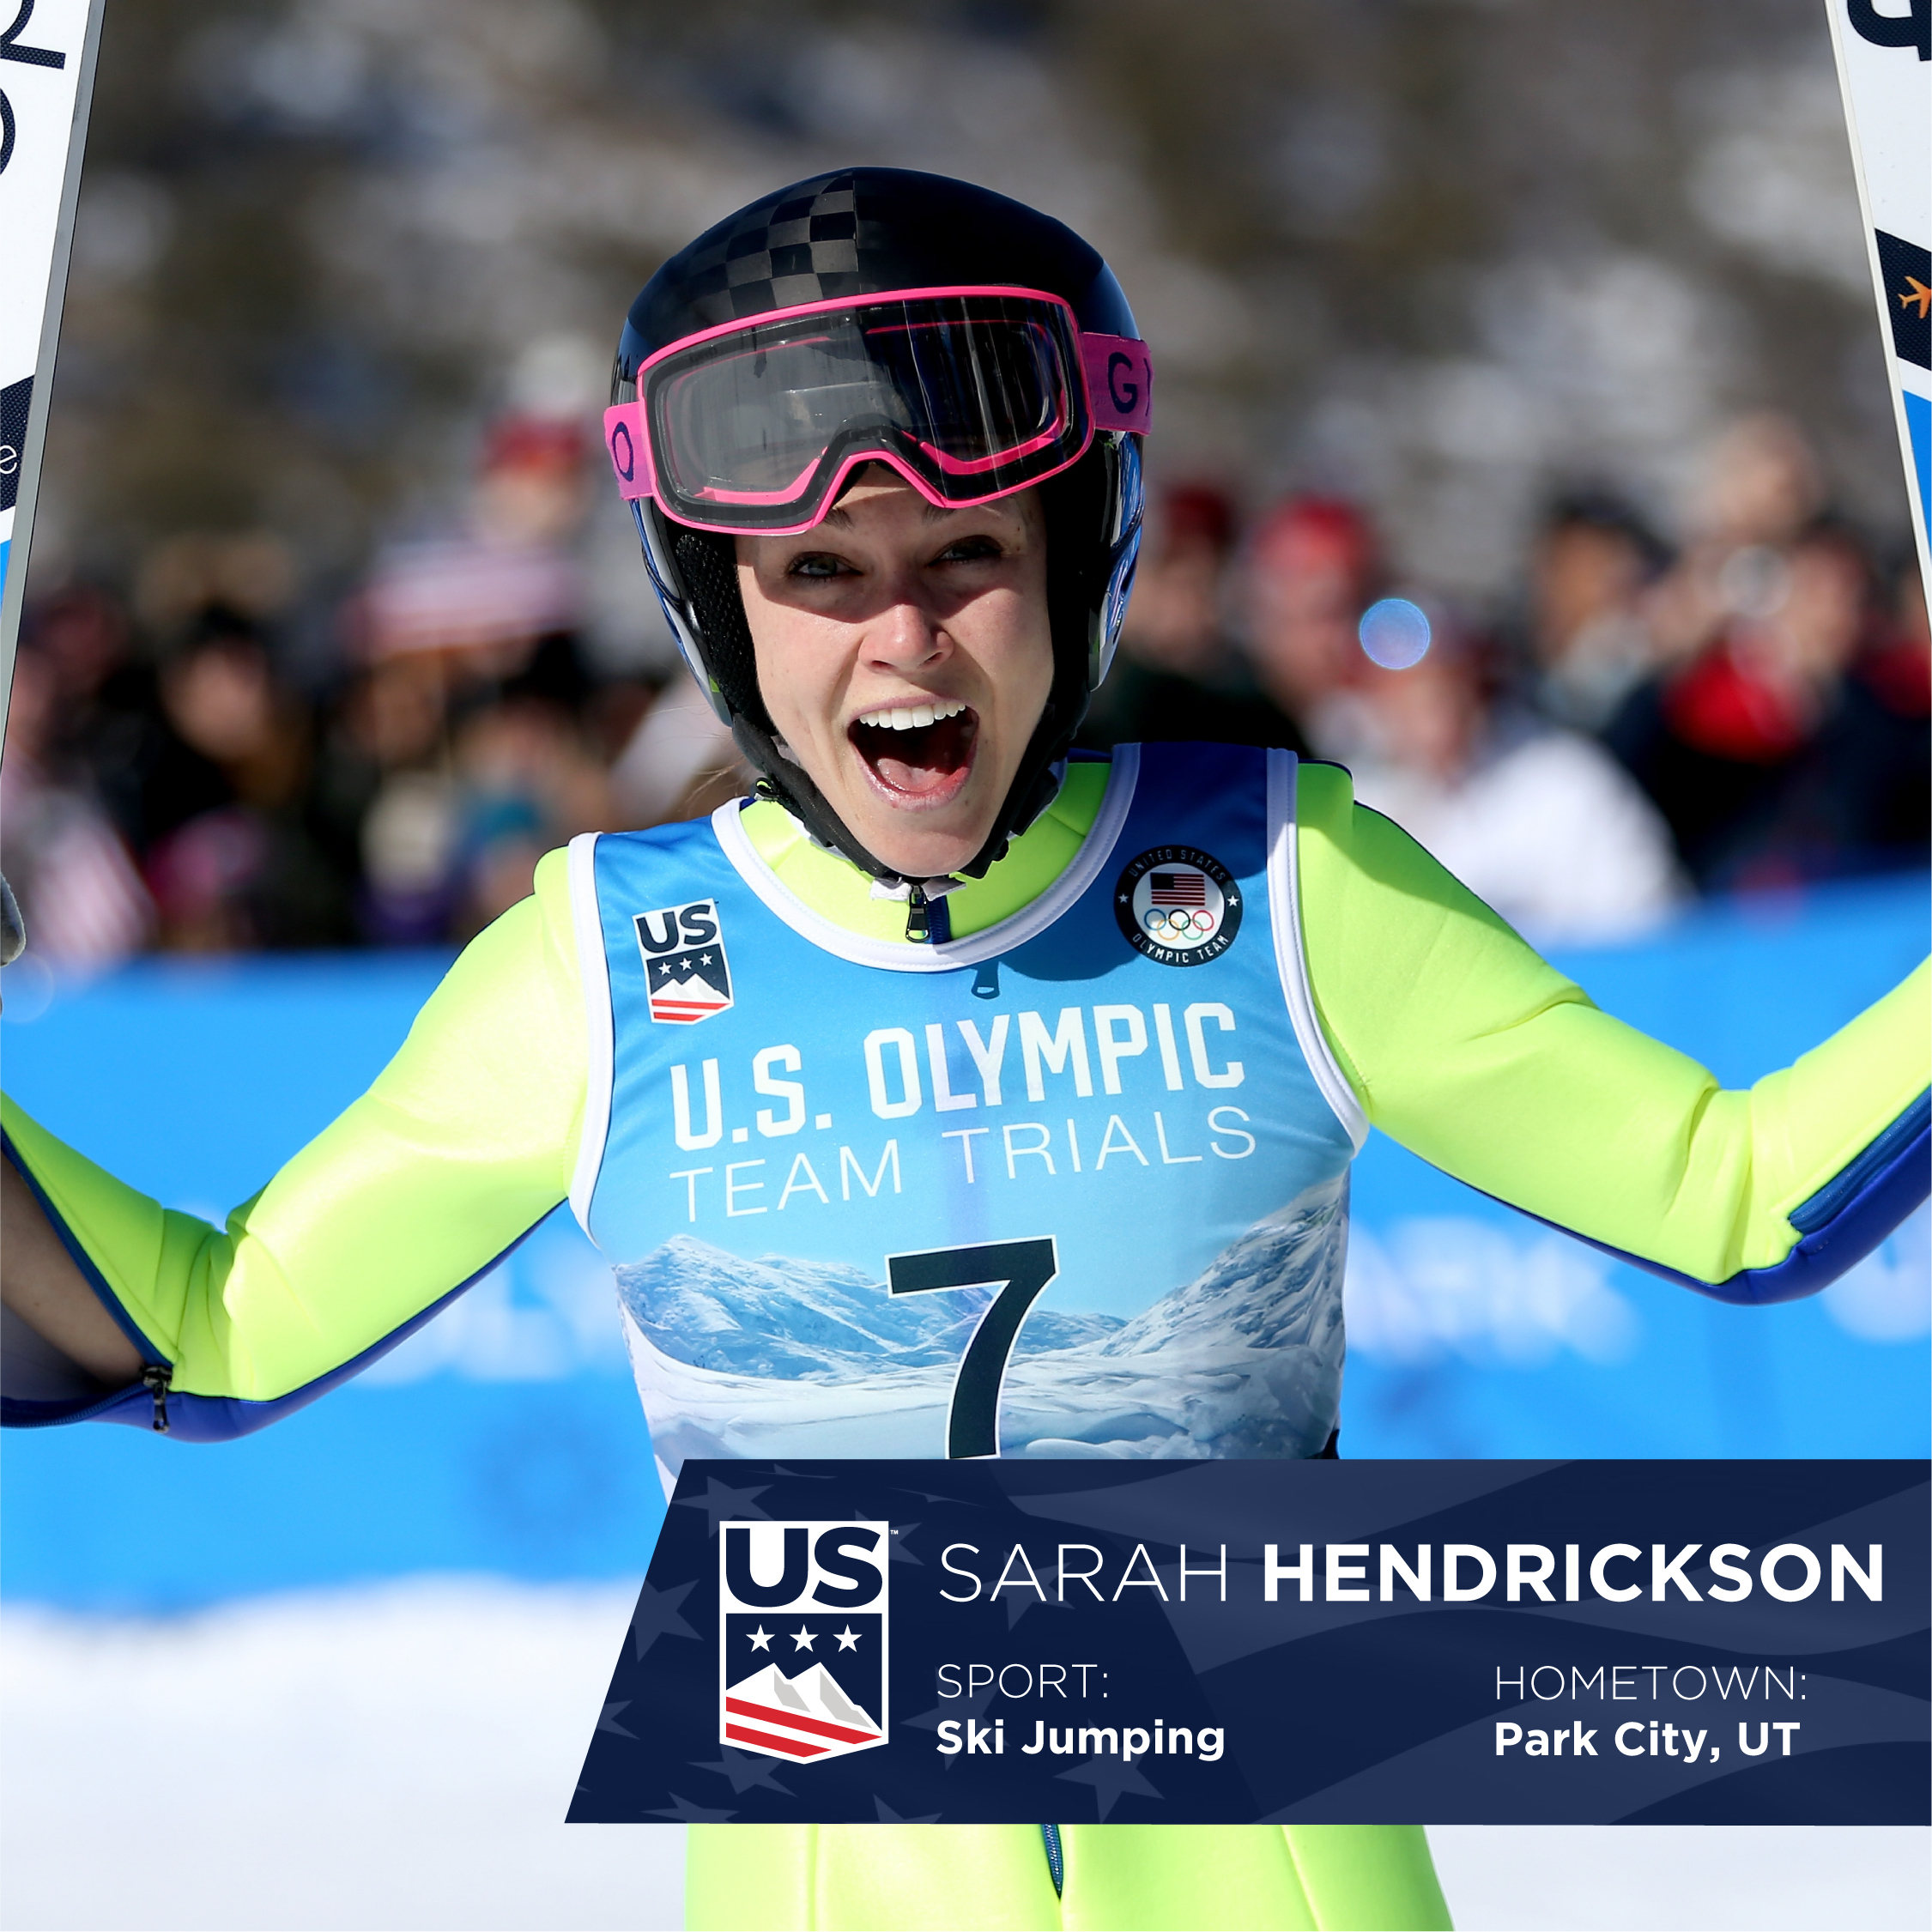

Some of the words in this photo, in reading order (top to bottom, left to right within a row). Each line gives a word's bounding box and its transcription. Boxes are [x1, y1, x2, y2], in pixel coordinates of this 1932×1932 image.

[1128, 849, 1173, 877] UNITED
[1180, 849, 1226, 881] STATES
[635, 904, 718, 954] US
[1132, 933, 1190, 964] OLYMPIC
[1196, 935, 1229, 960] TEAM
[669, 1043, 833, 1152] U.S.
[863, 1002, 1245, 1120] OLYMPIC
[669, 1138, 902, 1222] TEAM
[941, 1105, 1257, 1184] TRIALS
[887, 1237, 1057, 1459] 7
